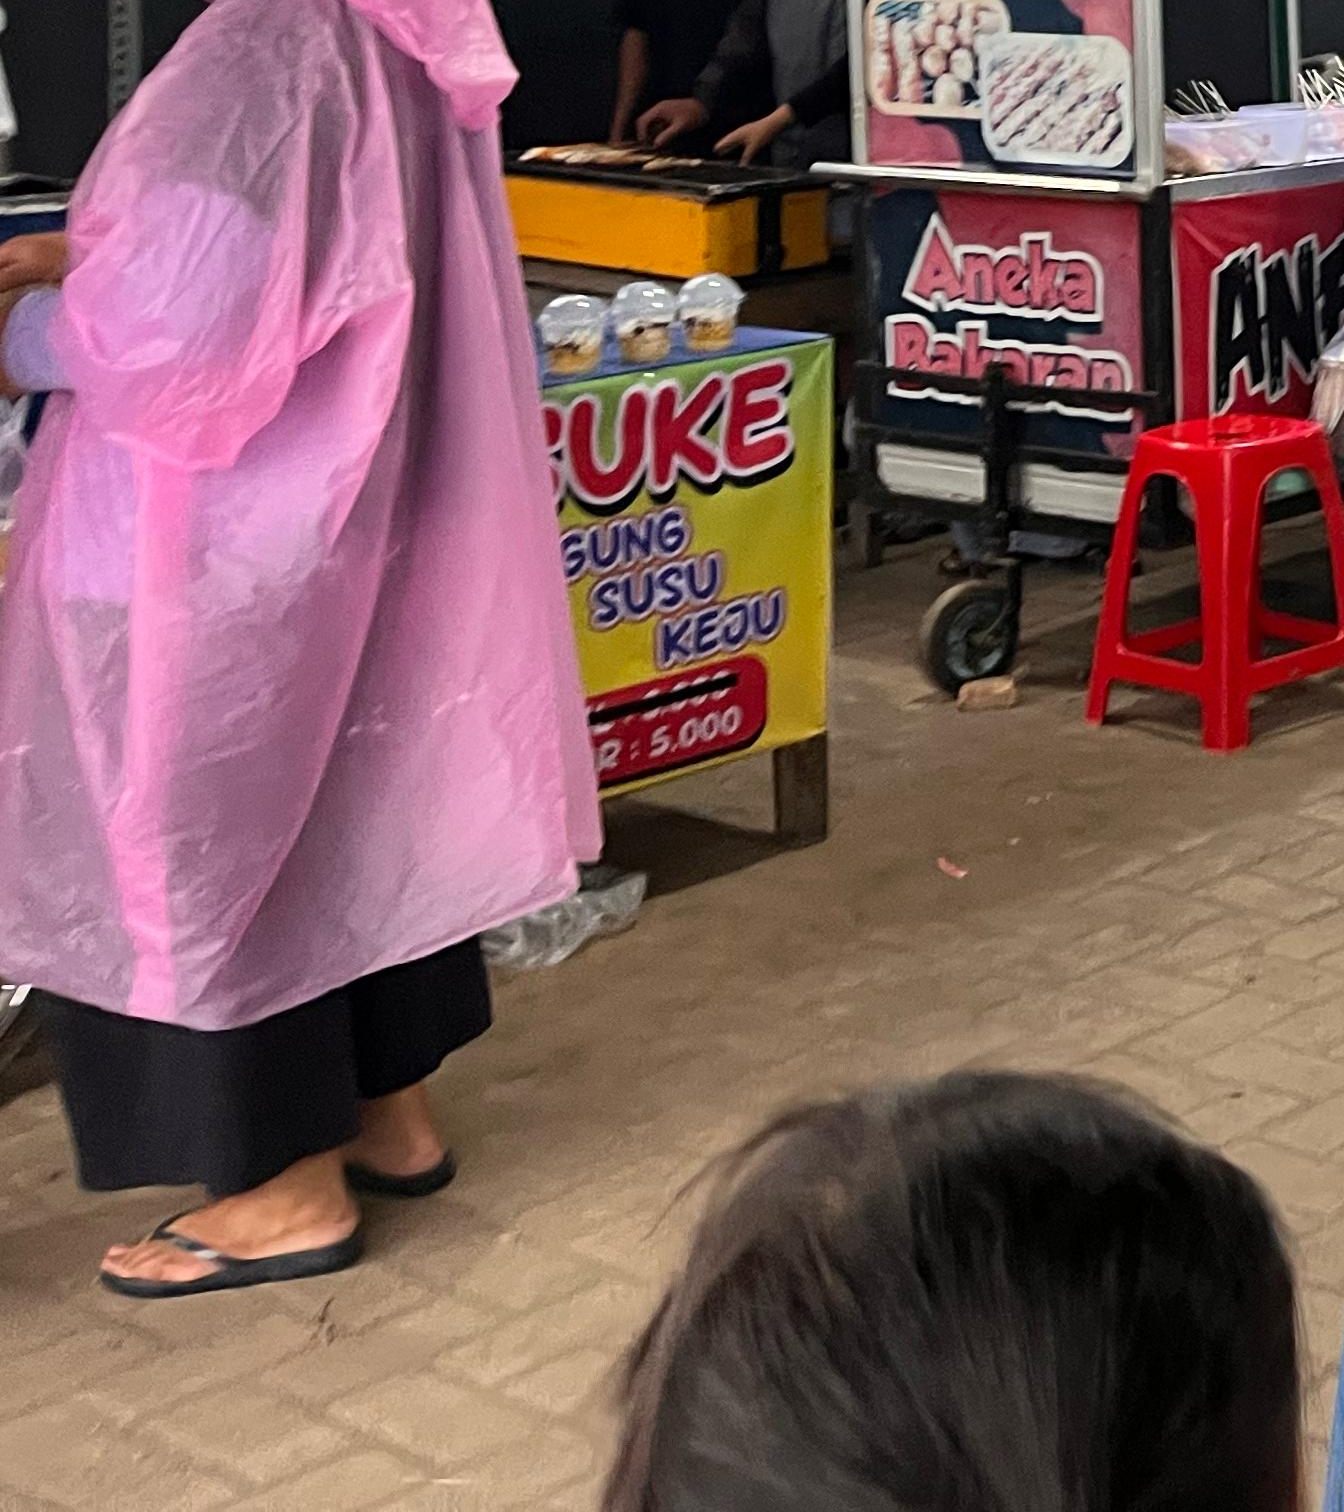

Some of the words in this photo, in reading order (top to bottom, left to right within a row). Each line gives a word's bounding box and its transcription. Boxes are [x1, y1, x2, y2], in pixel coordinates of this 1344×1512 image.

[902, 212, 1104, 322] Aneka
[592, 553, 723, 629] SUSU
[657, 591, 782, 666] KEJU
